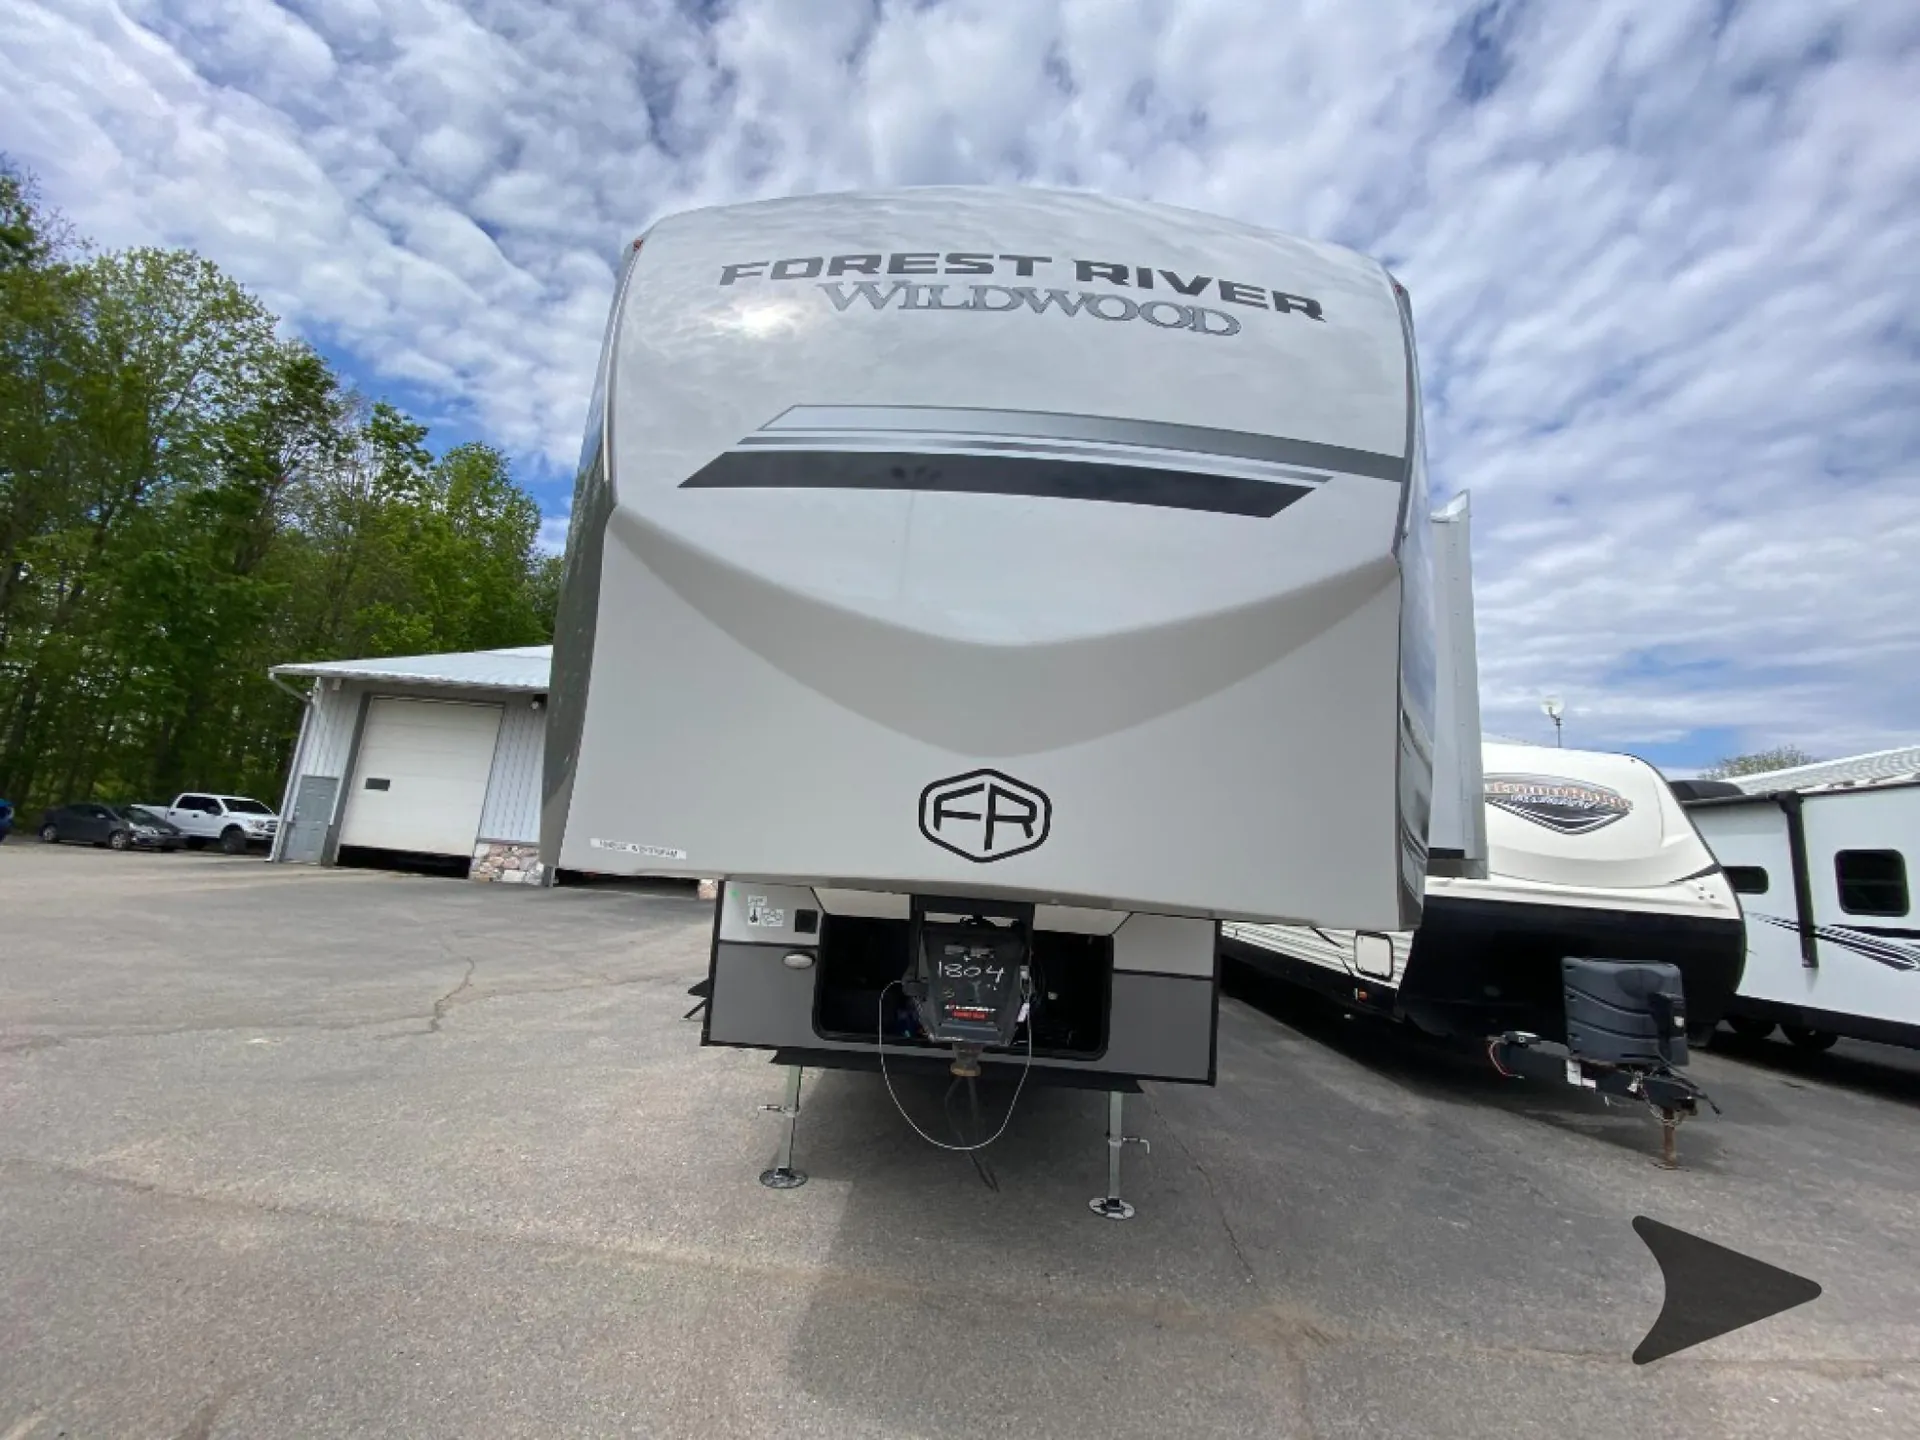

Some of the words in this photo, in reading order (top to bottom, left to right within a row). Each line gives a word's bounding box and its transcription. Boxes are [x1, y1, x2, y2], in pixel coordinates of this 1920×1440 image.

[720, 252, 1052, 287] FOREST
[1073, 258, 1326, 321] RIVER
[817, 280, 1242, 336] WILDWOOD
[933, 783, 1037, 851] FR
[938, 961, 1004, 983] 1804
